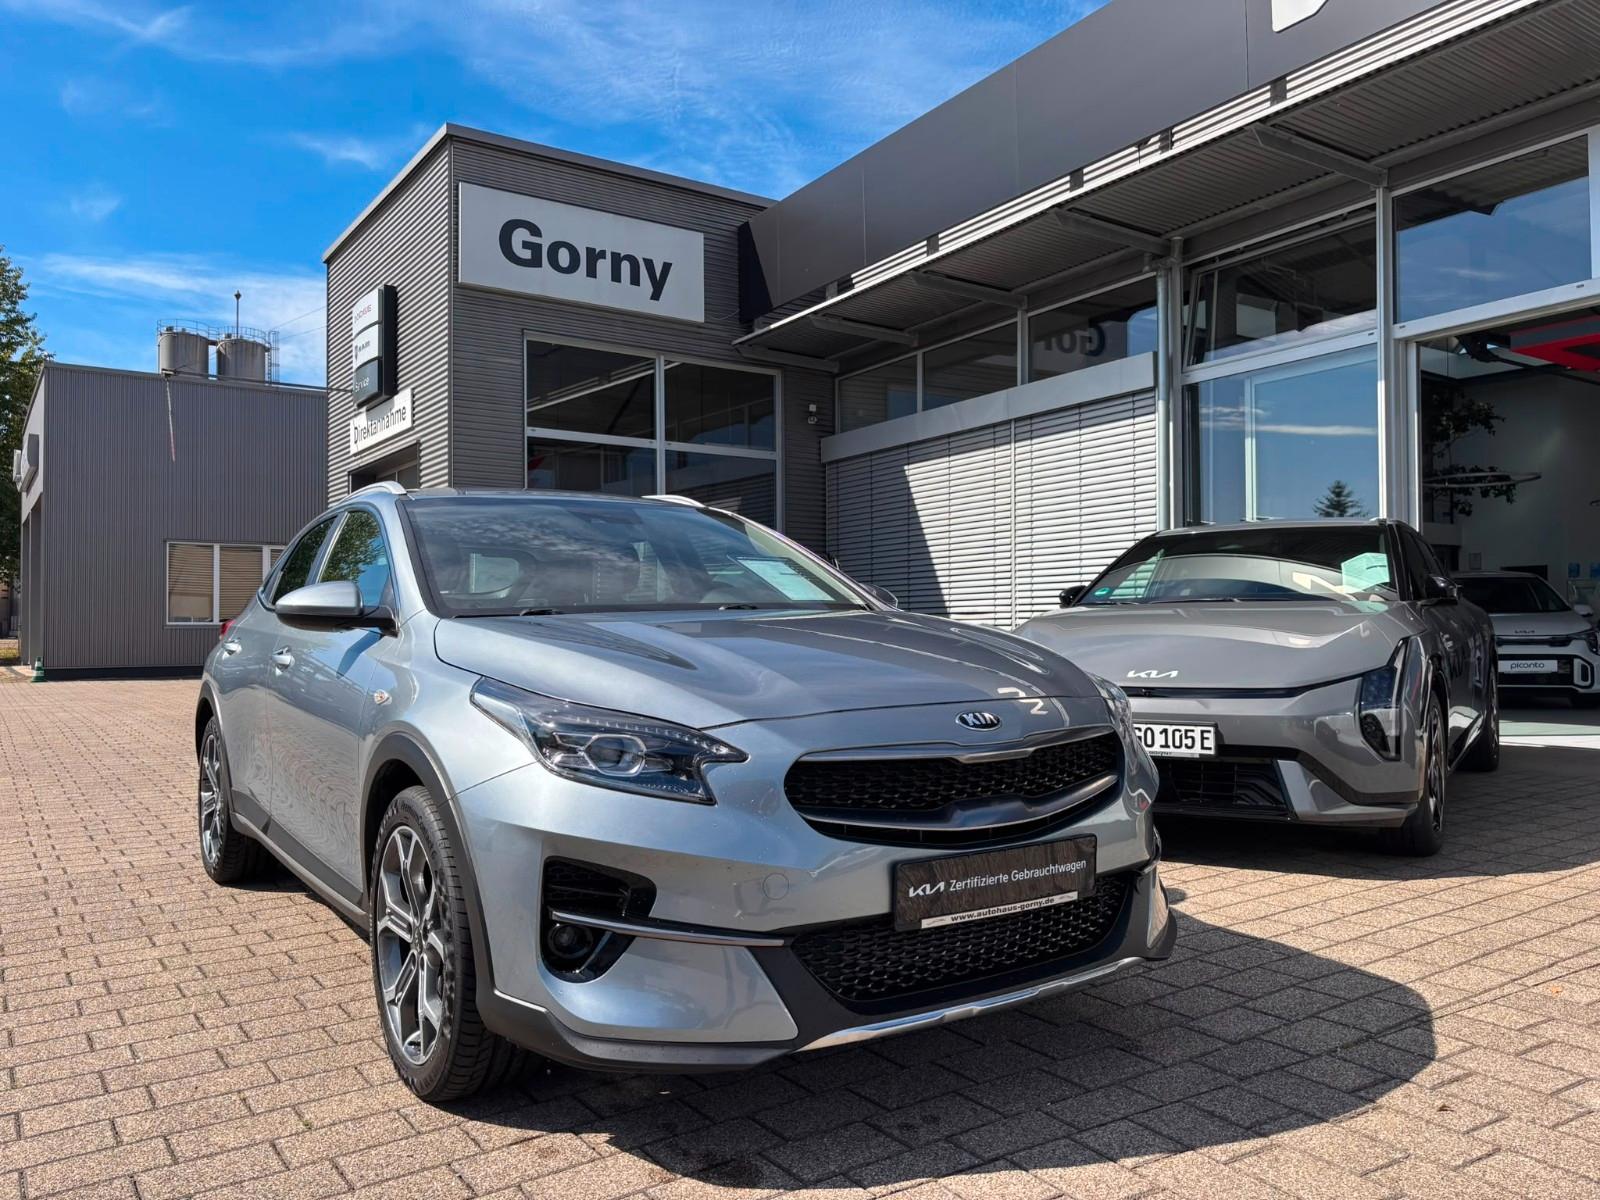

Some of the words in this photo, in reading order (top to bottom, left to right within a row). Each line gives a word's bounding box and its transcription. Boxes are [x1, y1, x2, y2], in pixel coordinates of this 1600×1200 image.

[498, 218, 673, 302] Gorny
[353, 405, 407, 445] Direktannahme
[1126, 670, 1179, 678] KIA
[962, 712, 998, 726] KIA
[908, 881, 945, 898] KIA
[949, 872, 1009, 892] Zertifizierte
[1011, 859, 1087, 882] Gebrauchtwagen
[950, 898, 1055, 922] www.autohaus-gorny.de
